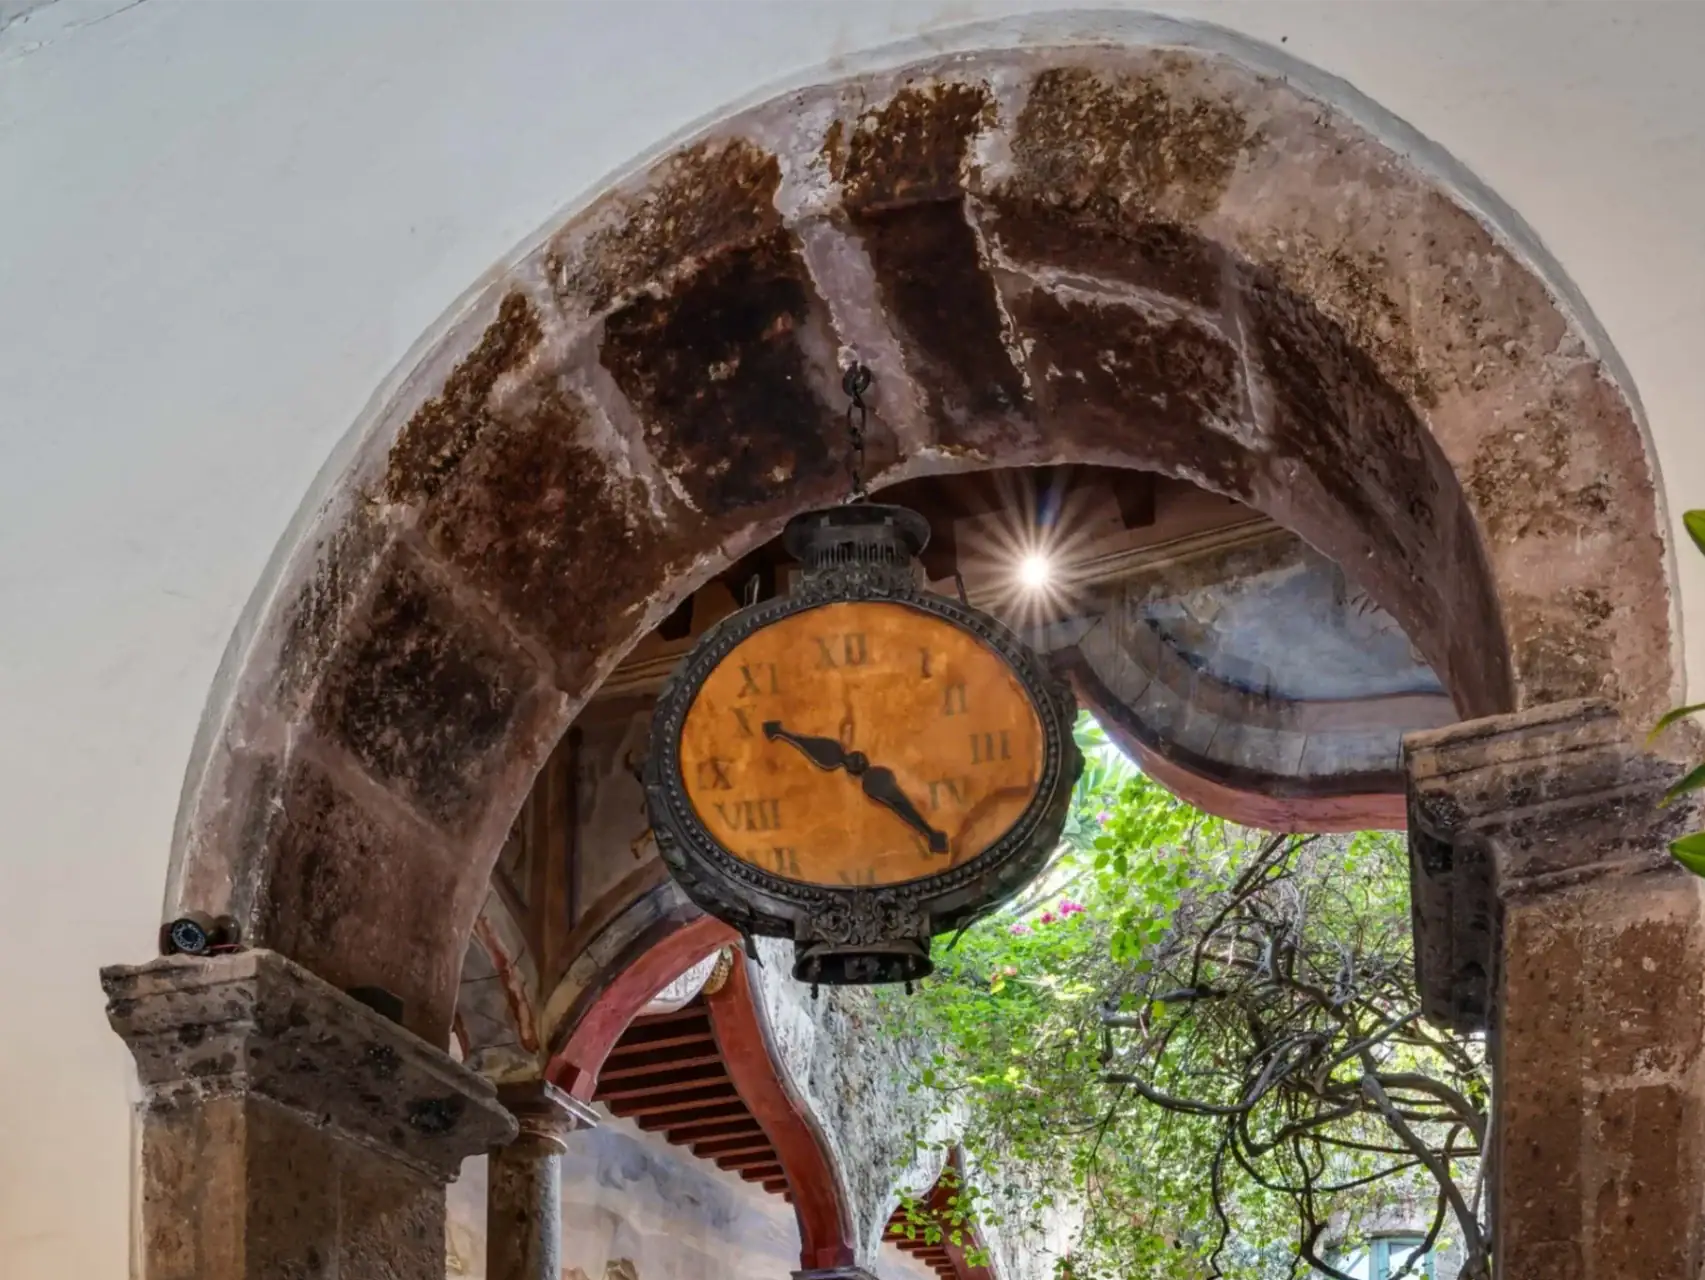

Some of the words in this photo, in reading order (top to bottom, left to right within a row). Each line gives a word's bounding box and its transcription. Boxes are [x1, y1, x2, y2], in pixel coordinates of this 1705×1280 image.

[738, 662, 781, 697] XI
[942, 683, 969, 717] II
[969, 730, 1012, 766] III
